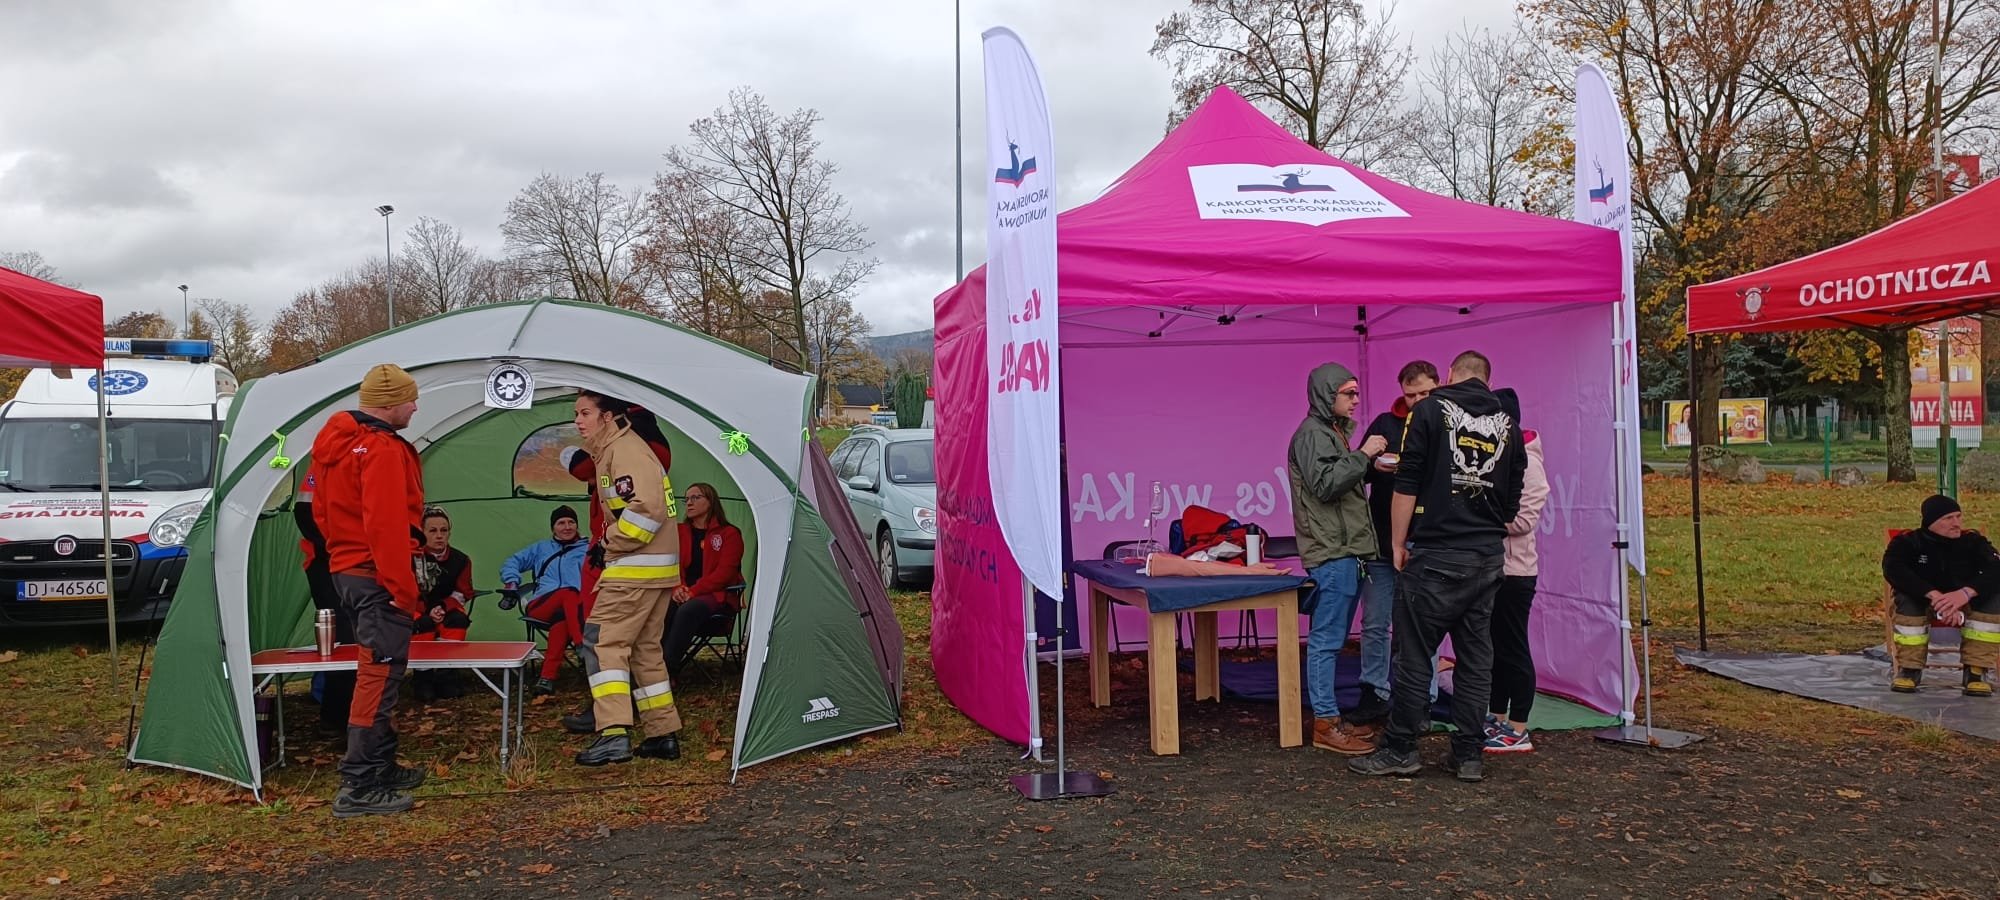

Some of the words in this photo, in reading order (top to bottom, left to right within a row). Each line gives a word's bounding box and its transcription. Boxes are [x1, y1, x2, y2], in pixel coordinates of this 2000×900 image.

[1206, 197, 1308, 208] KARKONOSKA
[1313, 198, 1387, 207] AKADEMIA
[1221, 206, 1265, 215] NAUK
[1268, 205, 1383, 214] STOSOWANYCH
[1798, 259, 1992, 307] OCHOTNICZA
[60, 542, 72, 553] FIAT
[28, 583, 48, 597] DJ
[56, 581, 106, 596] 4656C
[801, 708, 839, 724] TRESPASS
